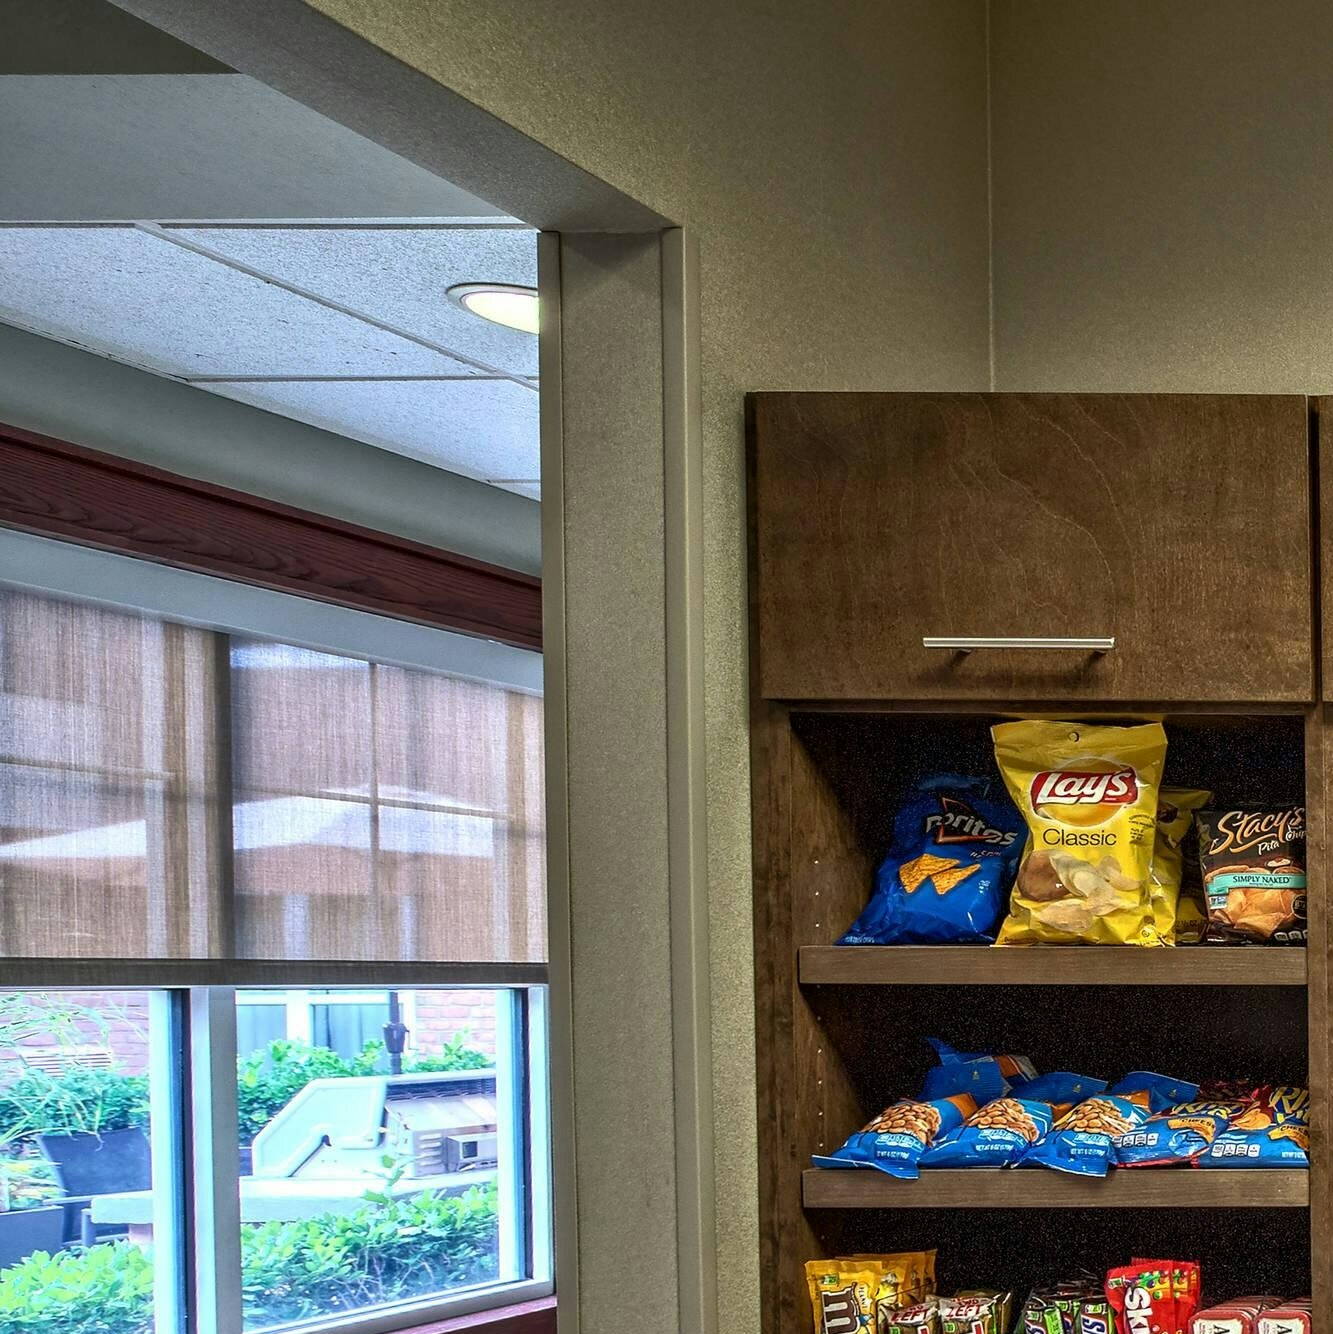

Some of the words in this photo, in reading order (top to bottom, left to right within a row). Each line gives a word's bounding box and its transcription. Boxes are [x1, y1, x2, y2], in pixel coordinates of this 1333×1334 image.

[1036, 771, 1133, 805] Lay's
[1042, 828, 1117, 846] Classic
[1208, 806, 1305, 855] Stacy's
[1233, 876, 1260, 884] SIMPLY
[1262, 876, 1290, 884] NAKED
